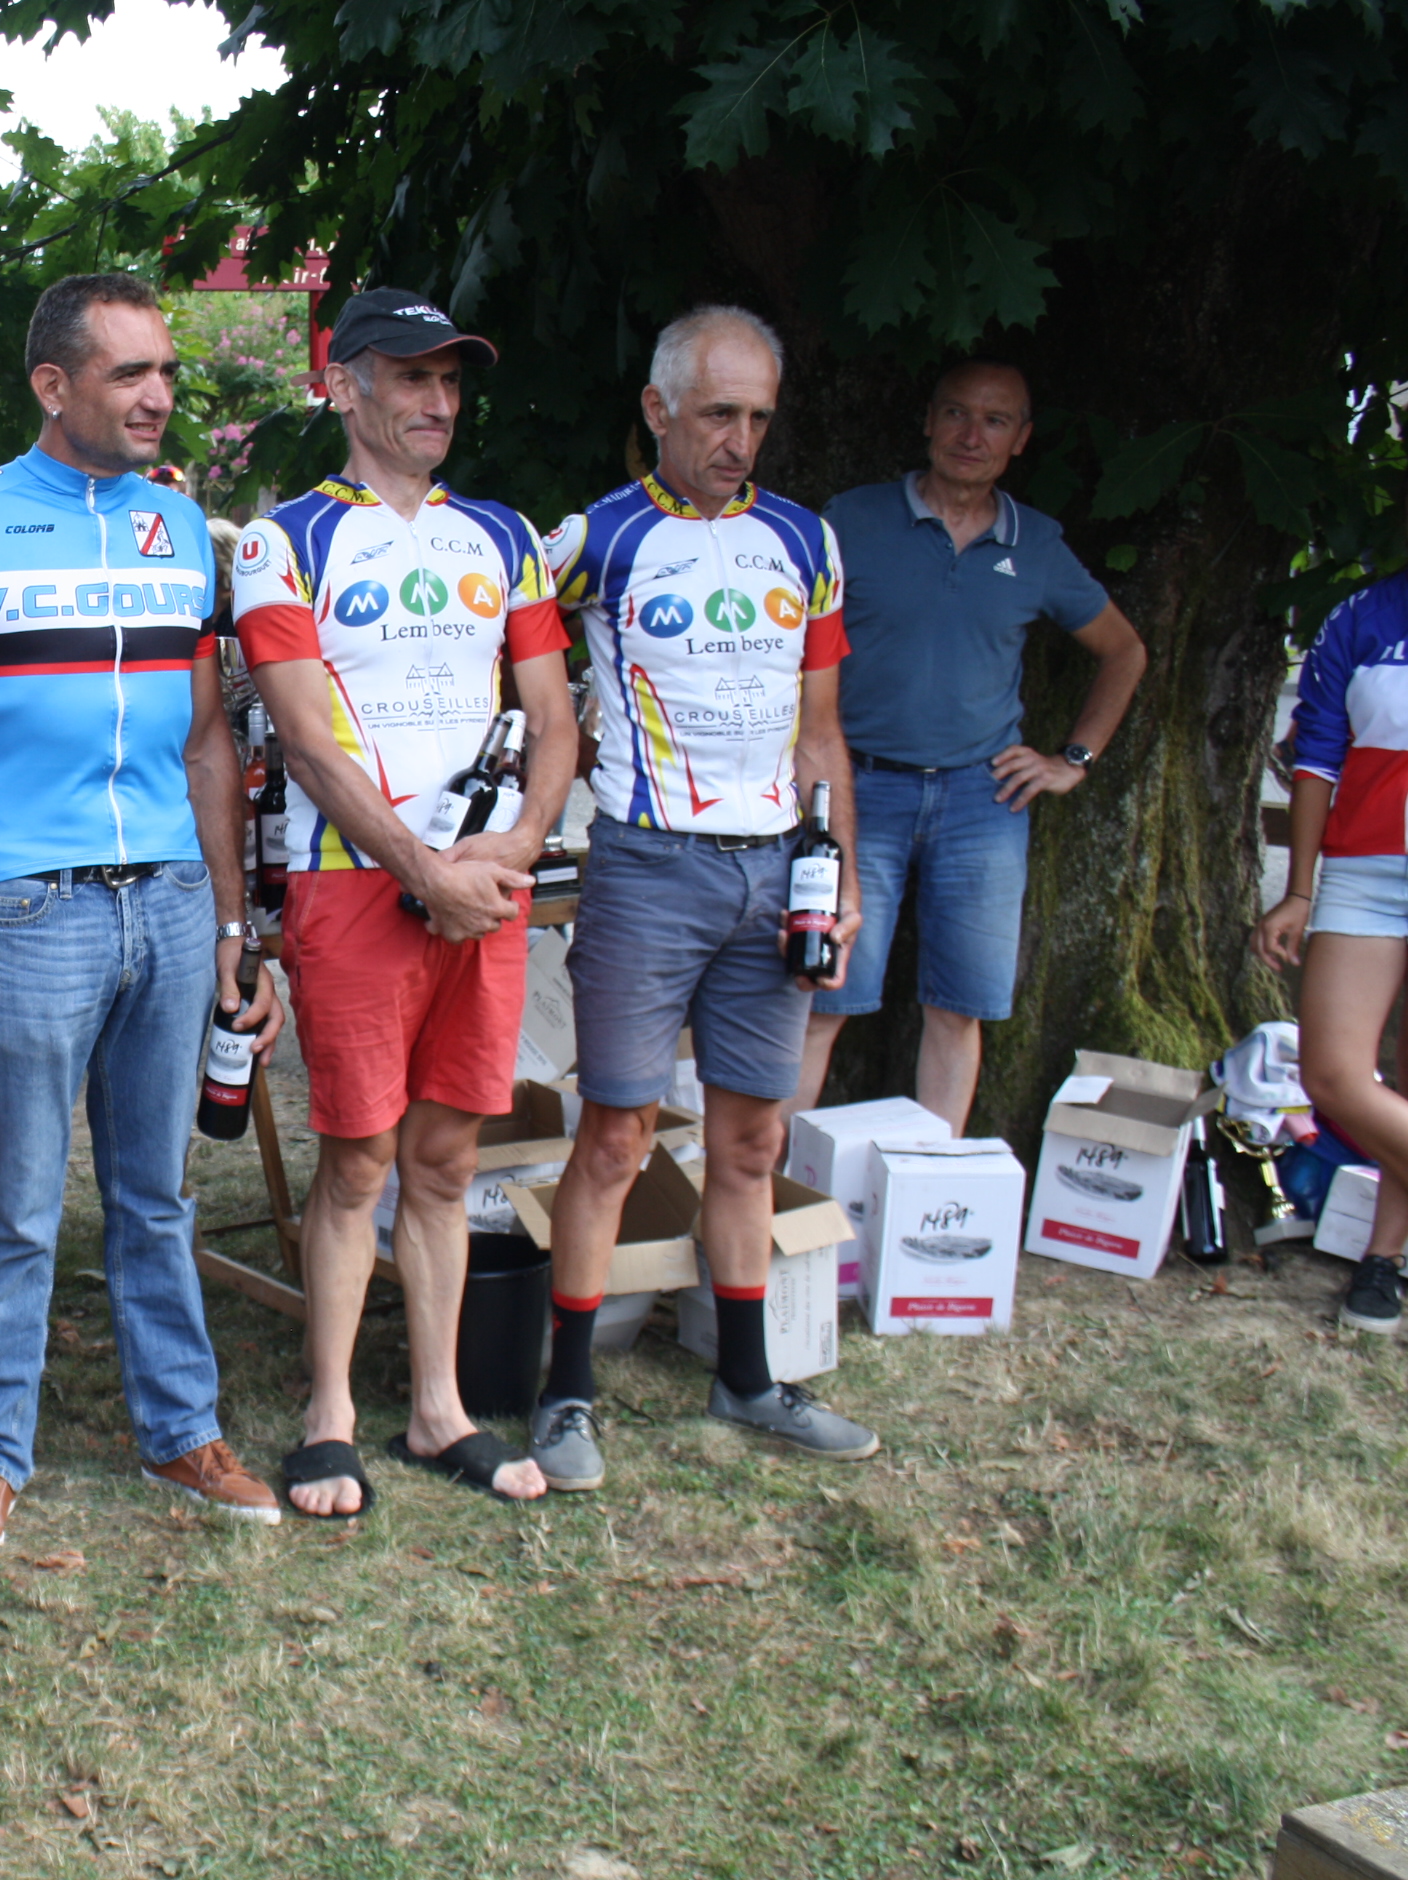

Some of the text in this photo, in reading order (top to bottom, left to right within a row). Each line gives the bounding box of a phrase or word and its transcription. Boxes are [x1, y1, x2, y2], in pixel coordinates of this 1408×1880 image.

[5, 524, 55, 534] COLOMB
[242, 540, 259, 561] U
[430, 537, 484, 556] C.C.M
[735, 554, 785, 573] C.C.M
[380, 622, 476, 641] Lembeye
[685, 635, 784, 655] Lembeye
[361, 697, 489, 715] CROUSEILLES
[674, 704, 795, 723] CROUSEILLES
